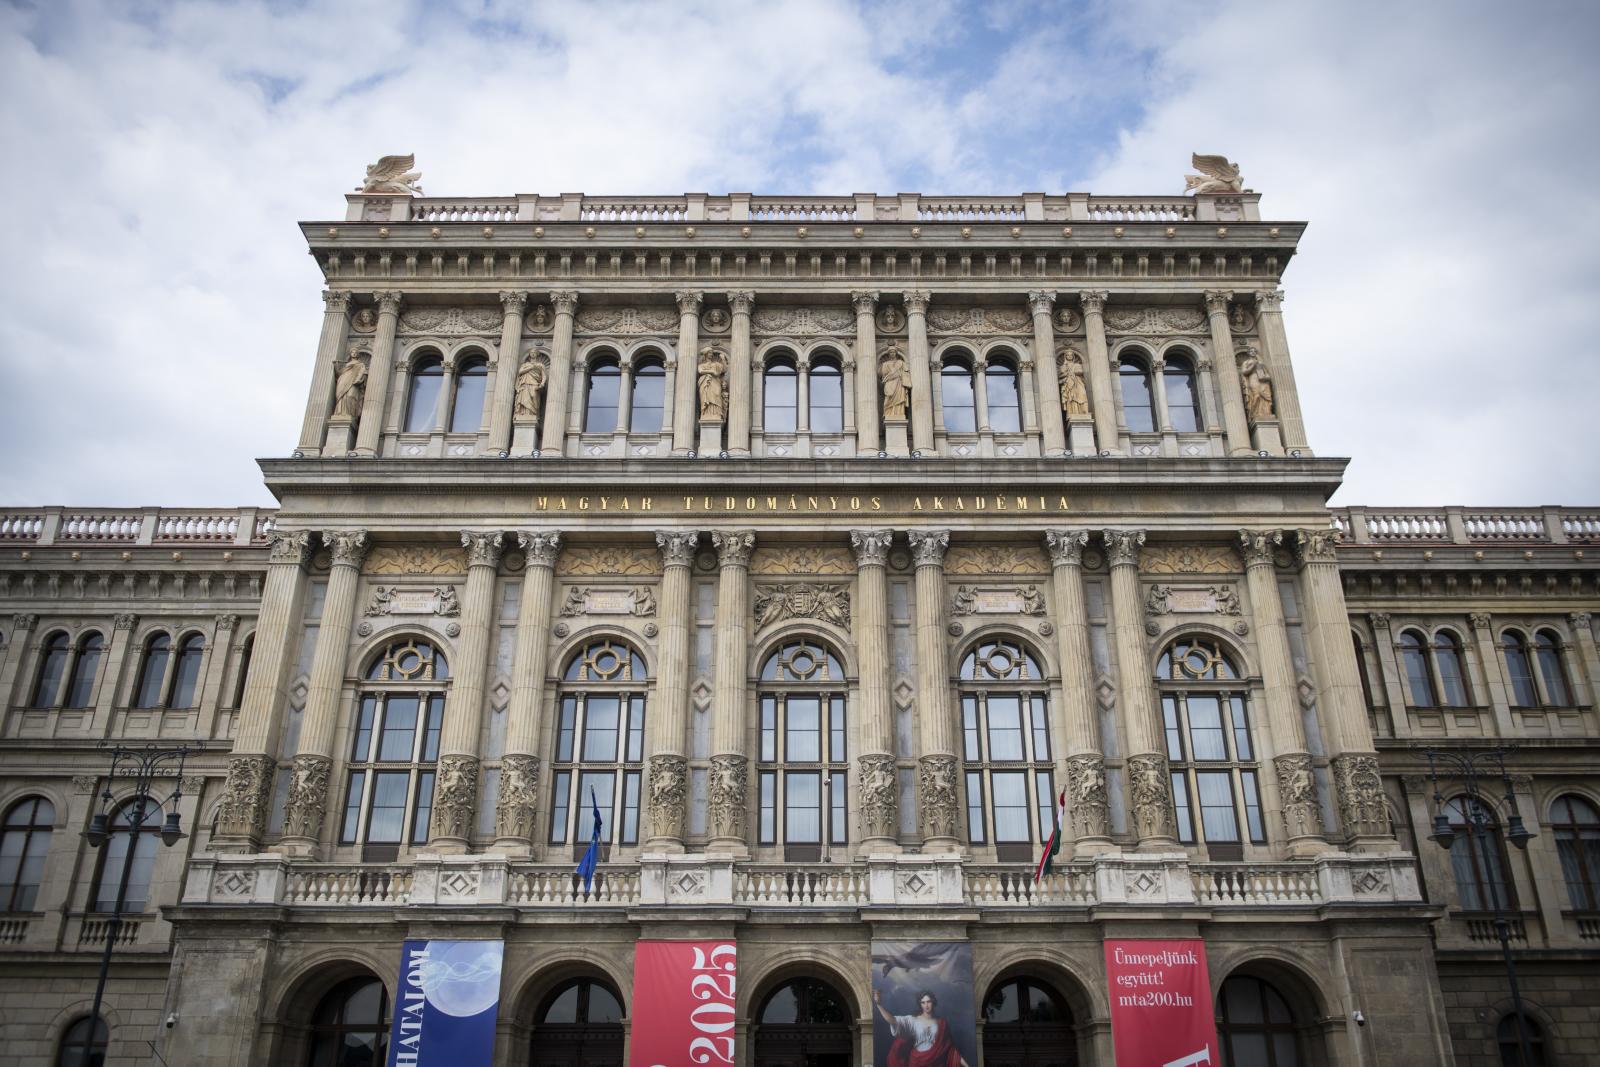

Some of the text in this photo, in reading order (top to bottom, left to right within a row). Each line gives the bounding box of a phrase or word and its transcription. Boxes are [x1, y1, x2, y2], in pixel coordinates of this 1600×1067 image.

[536, 494, 1069, 510] MAGYAR TUDOMÁNYOS AKADÉMIA
[1114, 946, 1199, 968] Ünnepeljünk
[1116, 970, 1165, 988] együtt!
[689, 944, 737, 1064] 2025
[1119, 991, 1194, 1007] mta200.hu
